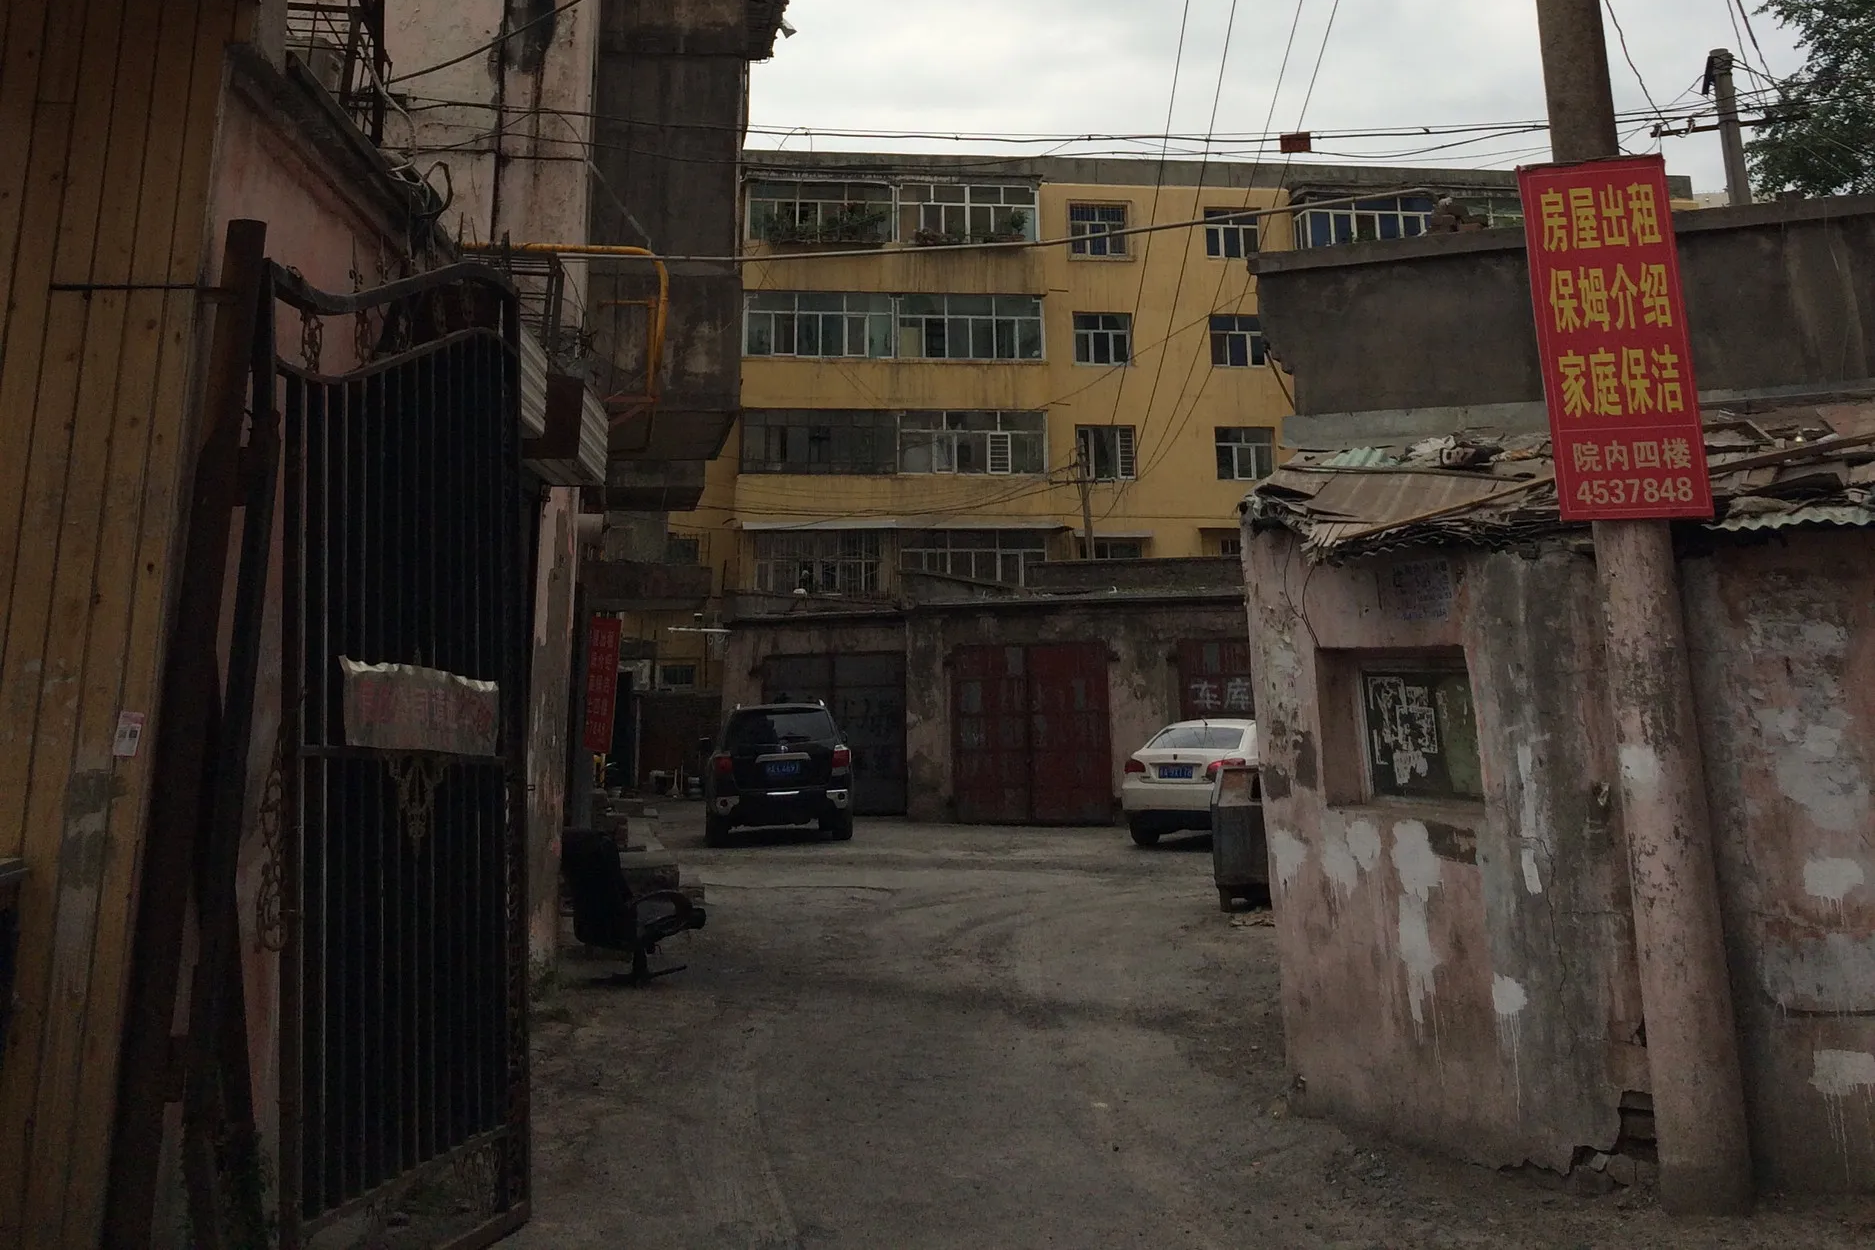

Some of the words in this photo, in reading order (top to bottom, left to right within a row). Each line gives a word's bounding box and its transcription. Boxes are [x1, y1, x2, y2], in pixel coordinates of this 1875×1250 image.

[1540, 182, 1662, 252] 房屋出租
[1549, 262, 1673, 333] 保姆介绍
[1558, 344, 1684, 418] 家庭保洁
[1572, 438, 1691, 472] 院内四楼
[1576, 477, 1694, 505] 4537848
[1190, 678, 1251, 710] 车库
